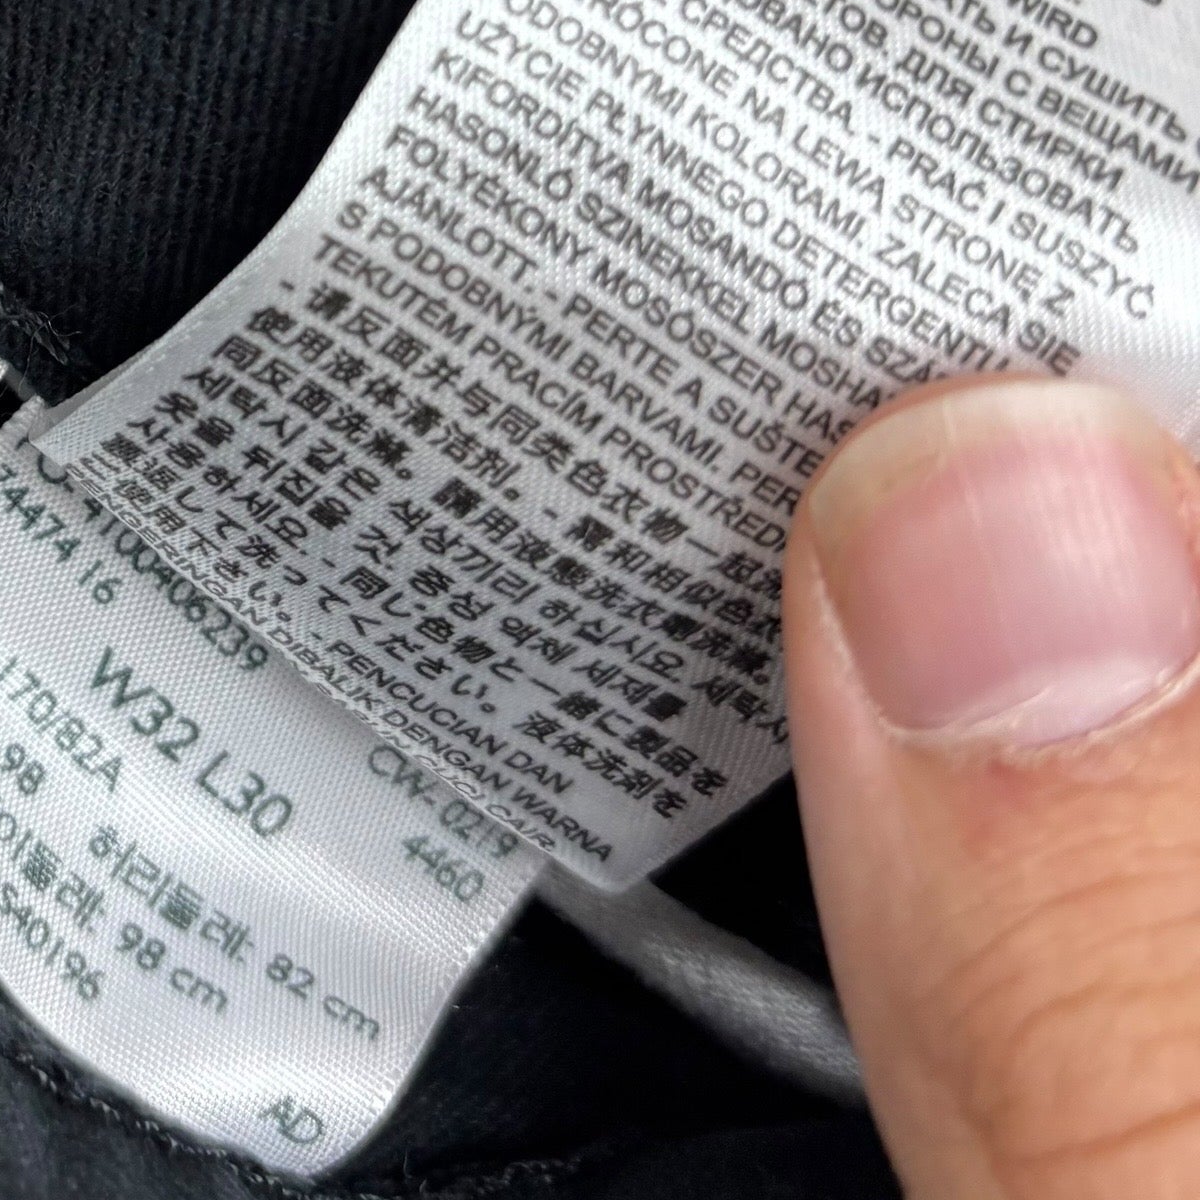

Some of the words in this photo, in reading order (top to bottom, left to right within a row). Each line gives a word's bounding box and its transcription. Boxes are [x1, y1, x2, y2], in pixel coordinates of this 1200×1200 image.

[454, 9, 585, 102] UŻYCIE
[586, 86, 771, 228] PŁYNNEGO
[856, 62, 1143, 255] ИСПОЛЬЗОВАТЬ
[897, 45, 973, 107] ДЛЯ
[977, 95, 1123, 193] СТИРКИ
[999, 22, 1035, 57] И
[1035, 42, 1192, 144] СУШИТЬ
[1036, 85, 1200, 193] ВЕЩАМИ
[385, 125, 591, 269] FOLYÉKONY
[591, 257, 783, 405] MOSÓSZER
[408, 85, 579, 204] HASONLÓ
[757, 318, 893, 417] MOSHA
[431, 45, 636, 192] KIFORDÍTVA
[635, 176, 813, 314] MOSANDÓ
[810, 294, 864, 348] ÉS
[864, 333, 947, 391] SZÁ
[687, 103, 871, 248] KOLORAMI.
[874, 231, 1015, 335] ZALECA
[739, 84, 790, 134] NA
[791, 123, 895, 214] LEWĄ
[891, 191, 1042, 302] STRONĘ
[1040, 280, 1076, 319] Z
[885, 136, 990, 213] PRAĆ
[1008, 209, 1160, 321] SUSZYĆ
[313, 236, 473, 346] TEKUTÉM
[473, 333, 602, 436] PRACÍM
[600, 421, 790, 556] PROSTŘED
[336, 199, 367, 232] S
[368, 216, 571, 362] PODOBNÝMI
[571, 349, 727, 473] BARVAMI.
[364, 162, 543, 293] AJÁNLOTT.
[563, 292, 678, 386] PERTE
[674, 372, 707, 408] A
[706, 392, 823, 480] SUŠTE
[155, 386, 235, 451] 옷을
[237, 442, 353, 535] 뒤집을
[356, 523, 401, 569] 것.
[408, 561, 492, 626] 중성
[496, 610, 575, 670] 액체
[182, 359, 306, 452] 세탁시
[304, 435, 382, 503] 같은
[384, 493, 538, 611] 색상끼리
[84, 646, 200, 763] W32
[197, 748, 296, 842] L30
[269, 626, 380, 713] DIBALIK
[382, 707, 507, 793] DENGAN
[513, 786, 611, 861] WARNA
[327, 636, 505, 758] PENCUCIAN
[505, 747, 571, 796] DAN
[113, 921, 168, 973] 98
[169, 965, 231, 1014] cm
[400, 831, 484, 906] 4460
[265, 951, 317, 1000] 82
[319, 993, 383, 1042] cm
[263, 1091, 327, 1152] AD
